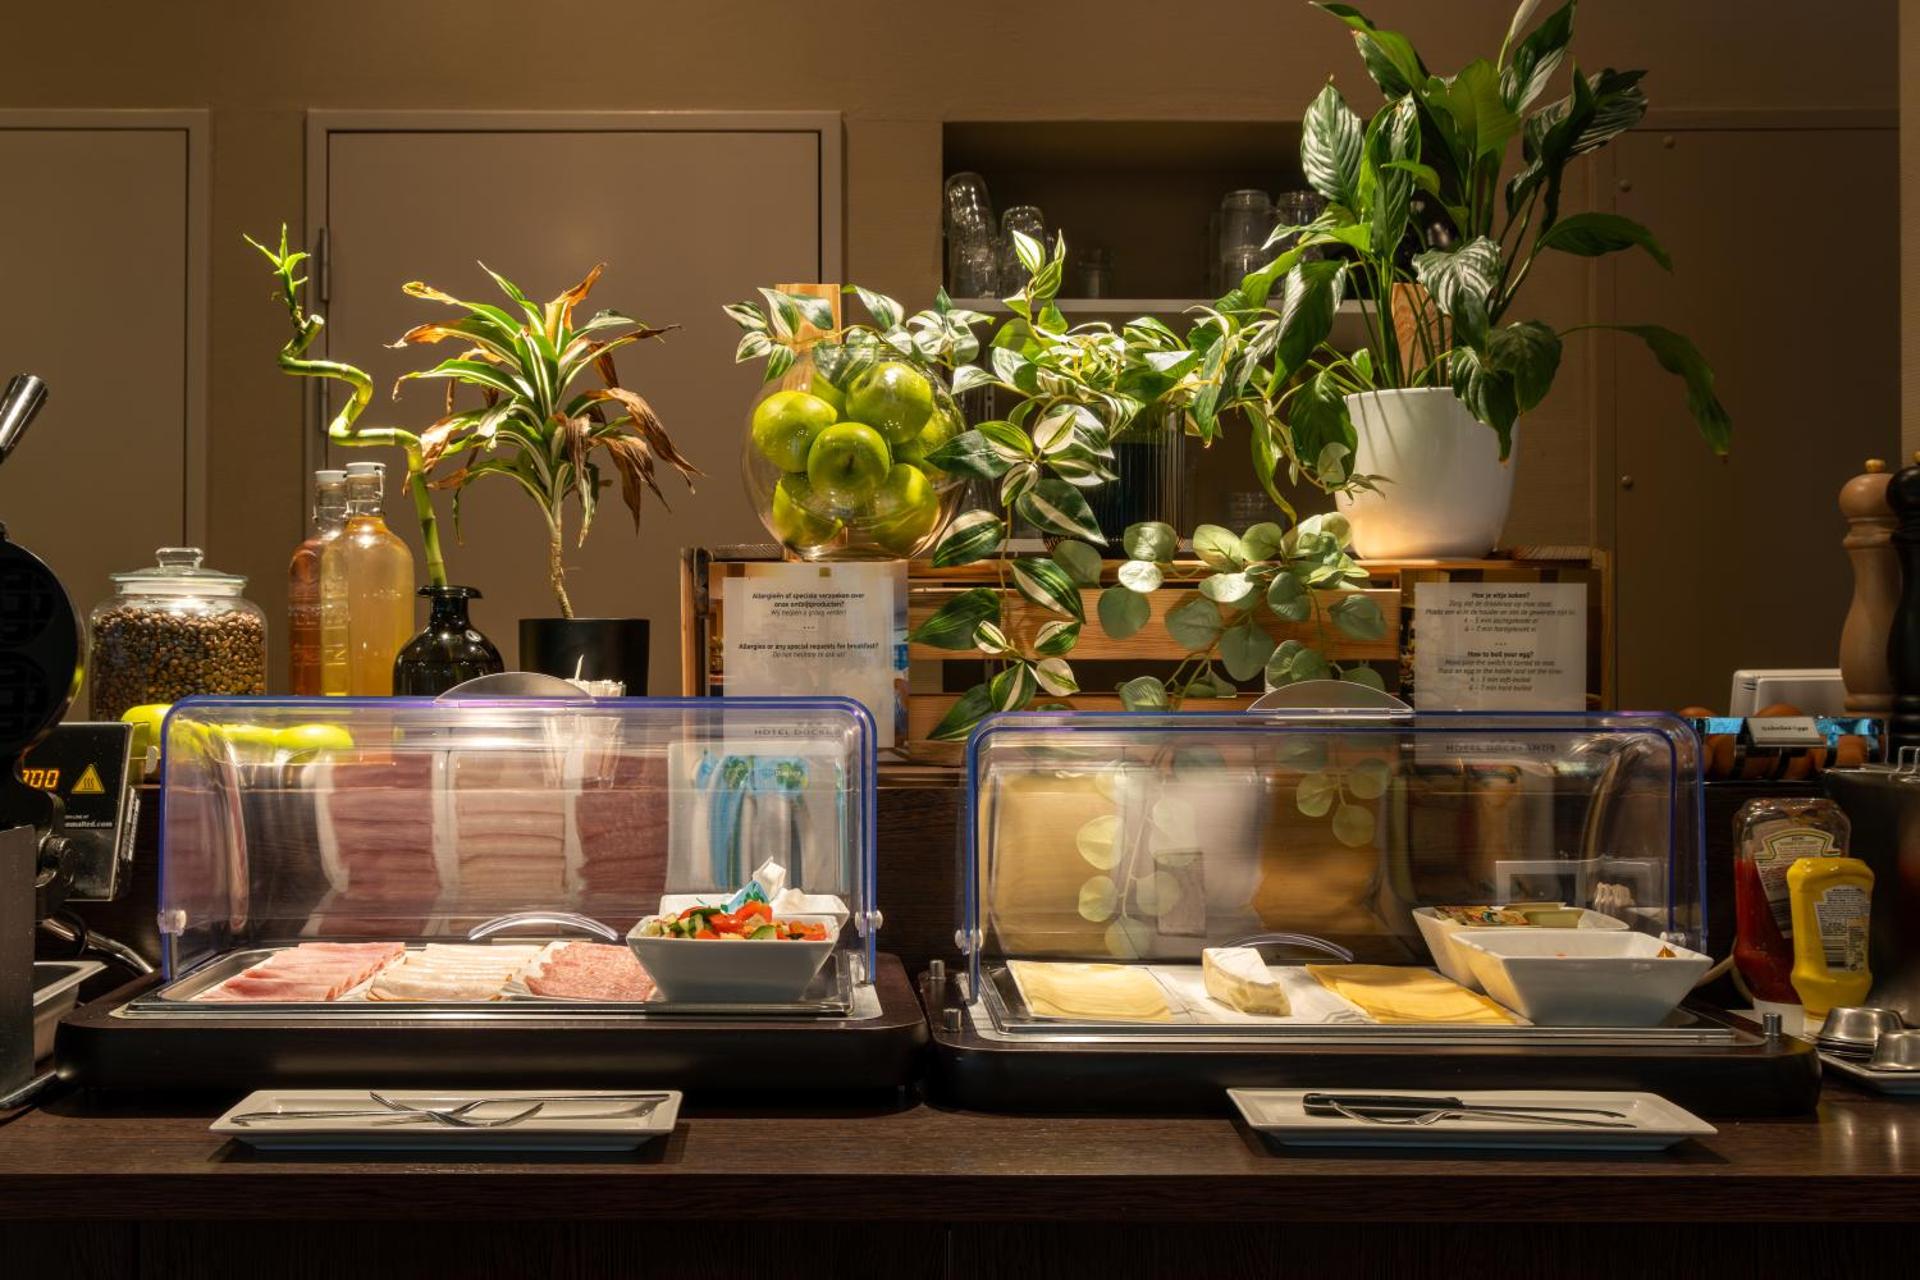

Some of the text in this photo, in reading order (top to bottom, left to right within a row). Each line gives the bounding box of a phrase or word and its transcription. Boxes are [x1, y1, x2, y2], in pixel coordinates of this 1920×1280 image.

[739, 642, 765, 651] Allergies
[767, 642, 773, 651] or
[775, 642, 786, 651] any
[787, 642, 808, 651] special
[810, 642, 835, 651] requests
[837, 642, 845, 651] for
[1482, 650, 1489, 658] to
[754, 728, 789, 737] HOTEL
